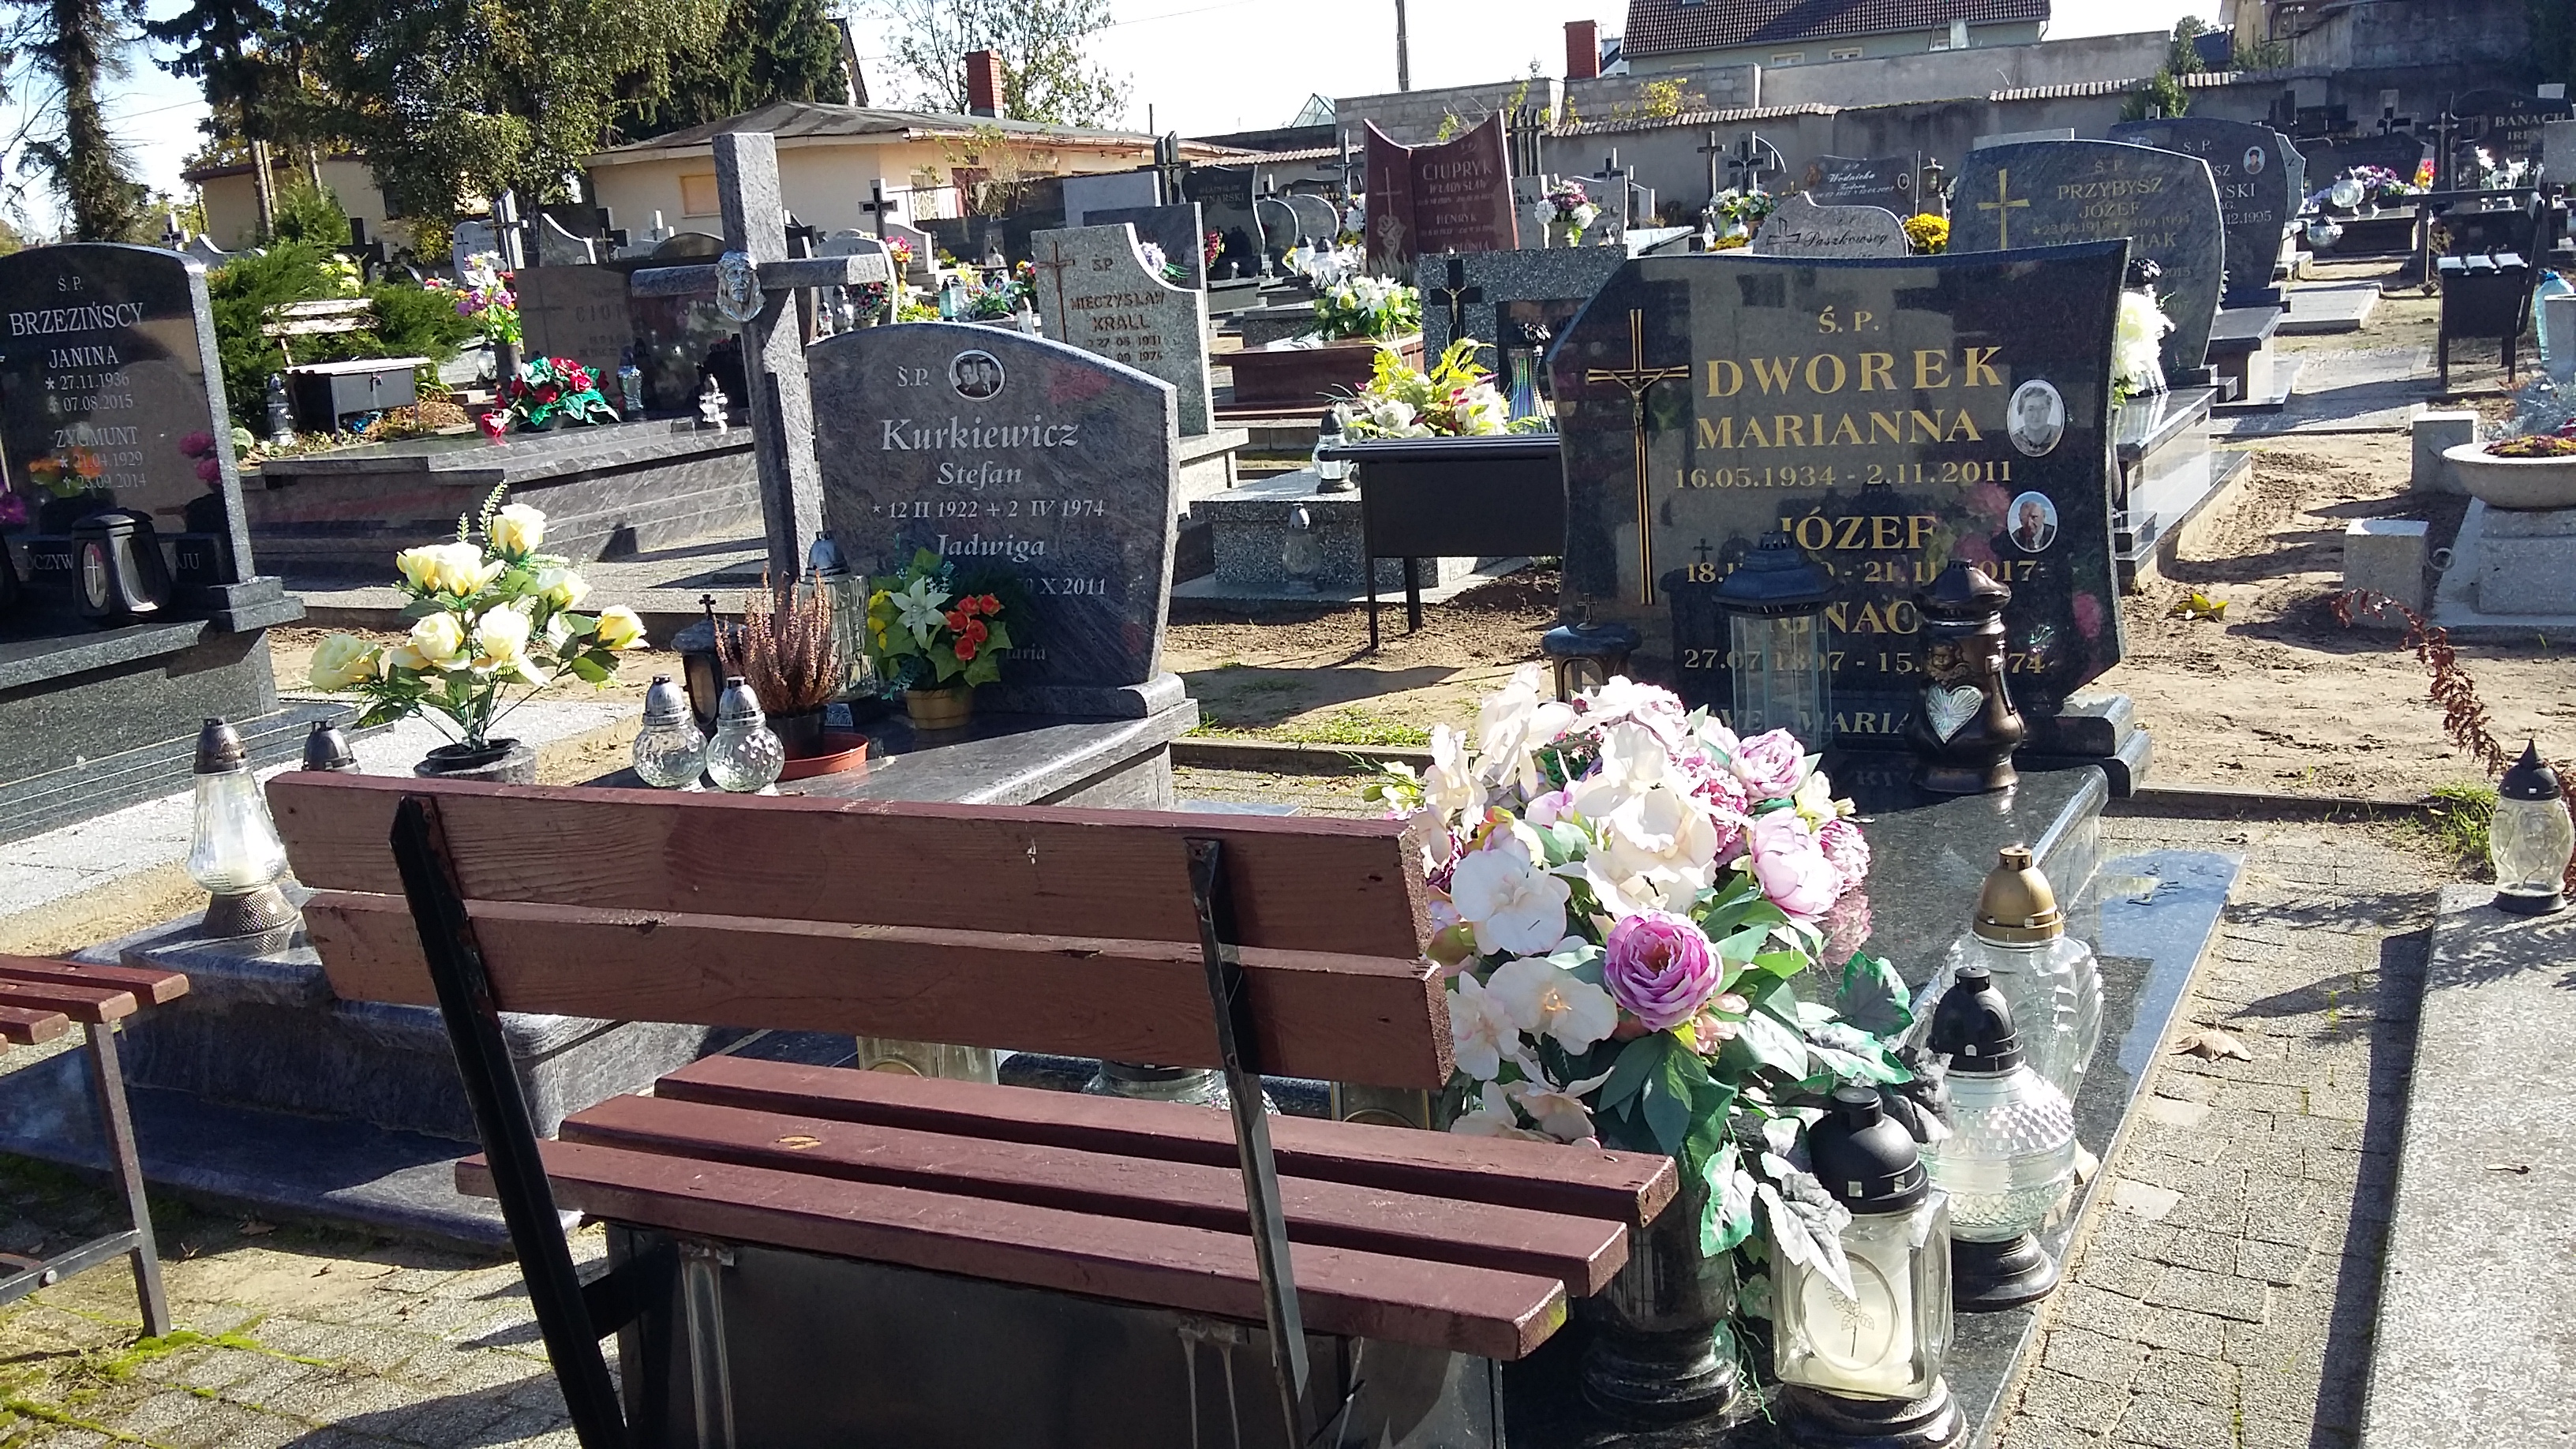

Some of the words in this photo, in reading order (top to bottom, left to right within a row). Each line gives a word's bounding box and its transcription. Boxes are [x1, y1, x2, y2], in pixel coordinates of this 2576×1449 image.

[1422, 159, 1492, 180] CIUPRYK
[2056, 176, 2163, 200] PRZYBYSZ
[9, 301, 144, 336] BRZEZIŃSCY
[1092, 313, 1151, 333] KRALL
[1853, 310, 1880, 332] P.
[48, 344, 120, 369] JANINA
[1705, 346, 2004, 398] DWOREK
[54, 425, 139, 448] ZYGMUNT
[881, 414, 1080, 451] Kurkiewicz
[1696, 408, 1983, 451] MARIANNA
[937, 460, 1023, 491] Stefan
[1675, 467, 1837, 489] 16.05.1934
[1866, 460, 2012, 486] 2.11.2011
[889, 502, 908, 519] 12
[938, 500, 979, 519] 1922
[1008, 500, 1019, 518] 2
[1030, 500, 1055, 518] IV
[1061, 499, 1106, 518] 1974
[1062, 577, 1106, 596] 2011
